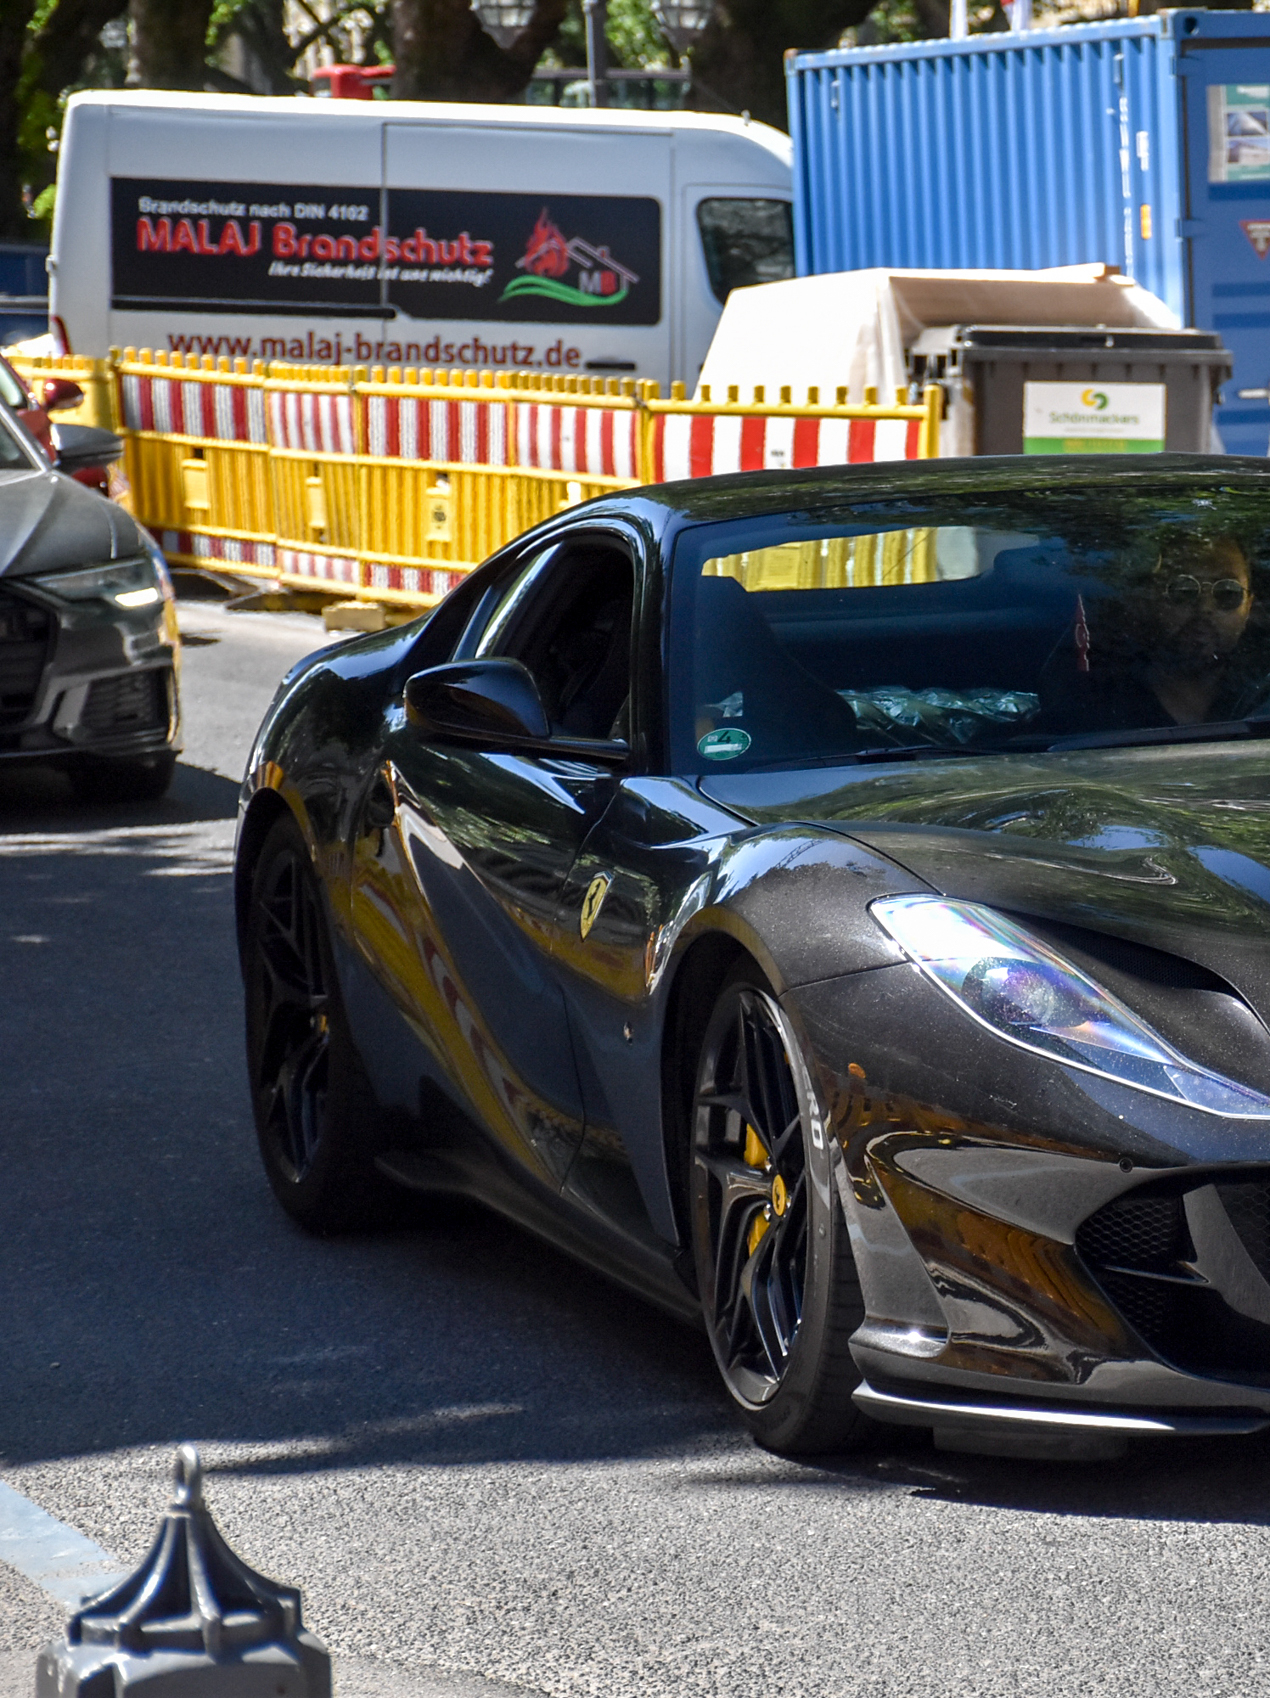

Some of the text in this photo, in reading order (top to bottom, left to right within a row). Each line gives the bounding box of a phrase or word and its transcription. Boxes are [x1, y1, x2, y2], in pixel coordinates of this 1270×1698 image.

[138, 196, 369, 221] Brandschutz nach DIN 4102
[136, 215, 493, 267] MALAJ Brandschutz
[168, 330, 582, 367] www.malaj-brandschutz.de
[717, 730, 732, 743] 4
